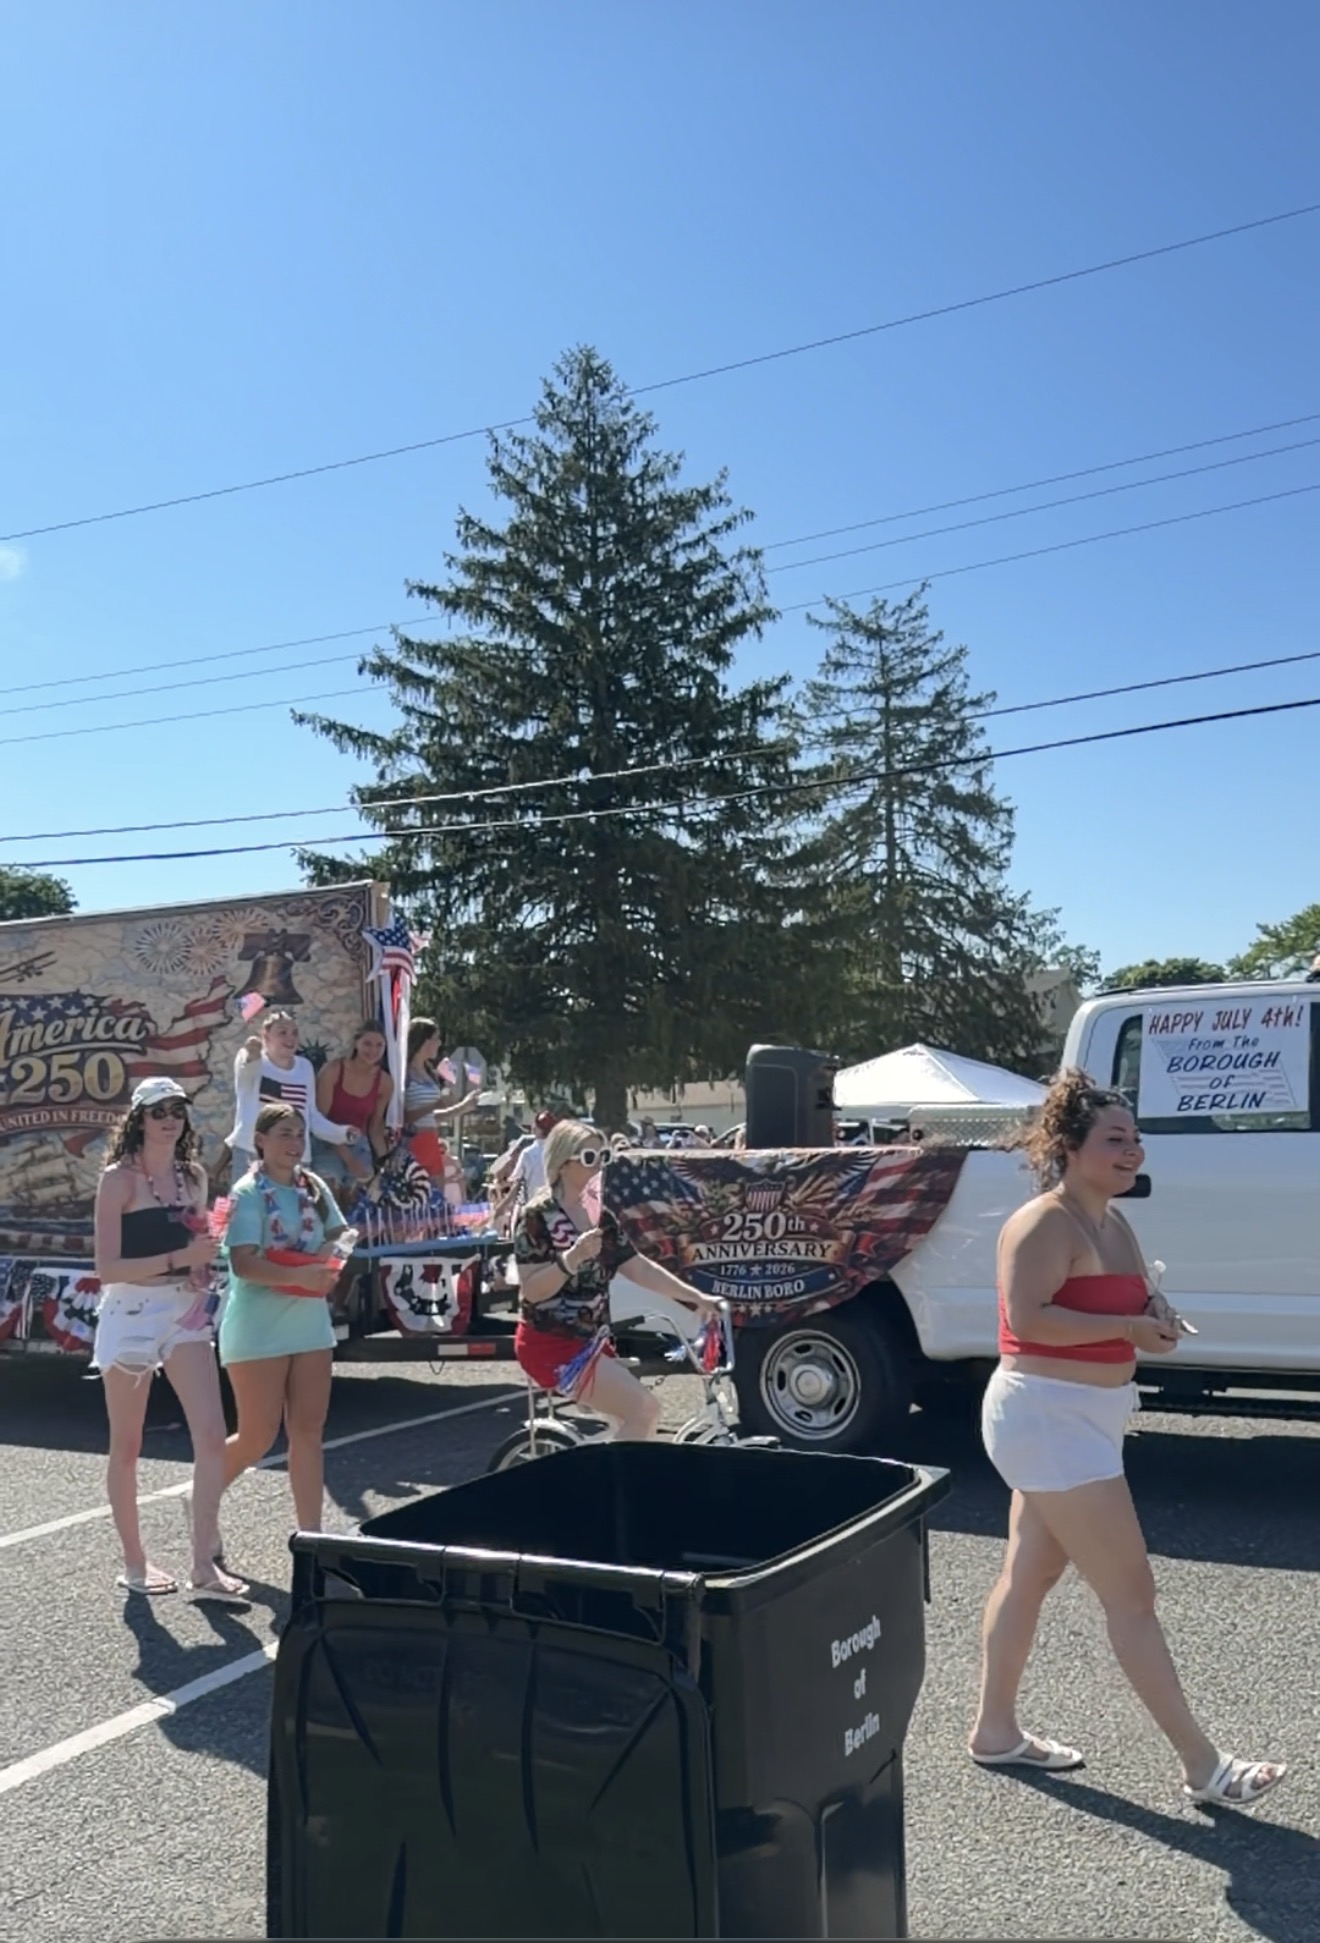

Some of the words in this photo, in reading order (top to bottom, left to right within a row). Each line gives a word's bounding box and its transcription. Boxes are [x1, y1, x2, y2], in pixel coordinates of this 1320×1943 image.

[1149, 1011, 1204, 1034] HAPPY
[1212, 1008, 1252, 1031] JULY
[1260, 1005, 1304, 1029] 4th!
[1166, 1051, 1281, 1073] BOROUGH
[10, 1052, 125, 1103] 250
[1177, 1091, 1266, 1112] BERLIN
[52, 1109, 69, 1122] IN
[71, 1110, 127, 1126] FREED
[721, 1212, 806, 1241] 250th
[692, 1242, 832, 1261] ANNIVERSARY
[720, 1264, 747, 1276] 1776
[764, 1263, 796, 1275] 2026
[711, 1280, 762, 1299] BERLIN
[764, 1279, 805, 1298] BORO
[831, 1615, 881, 1668] Borough
[854, 1668, 866, 1699] of
[845, 1712, 880, 1757] Berlin
